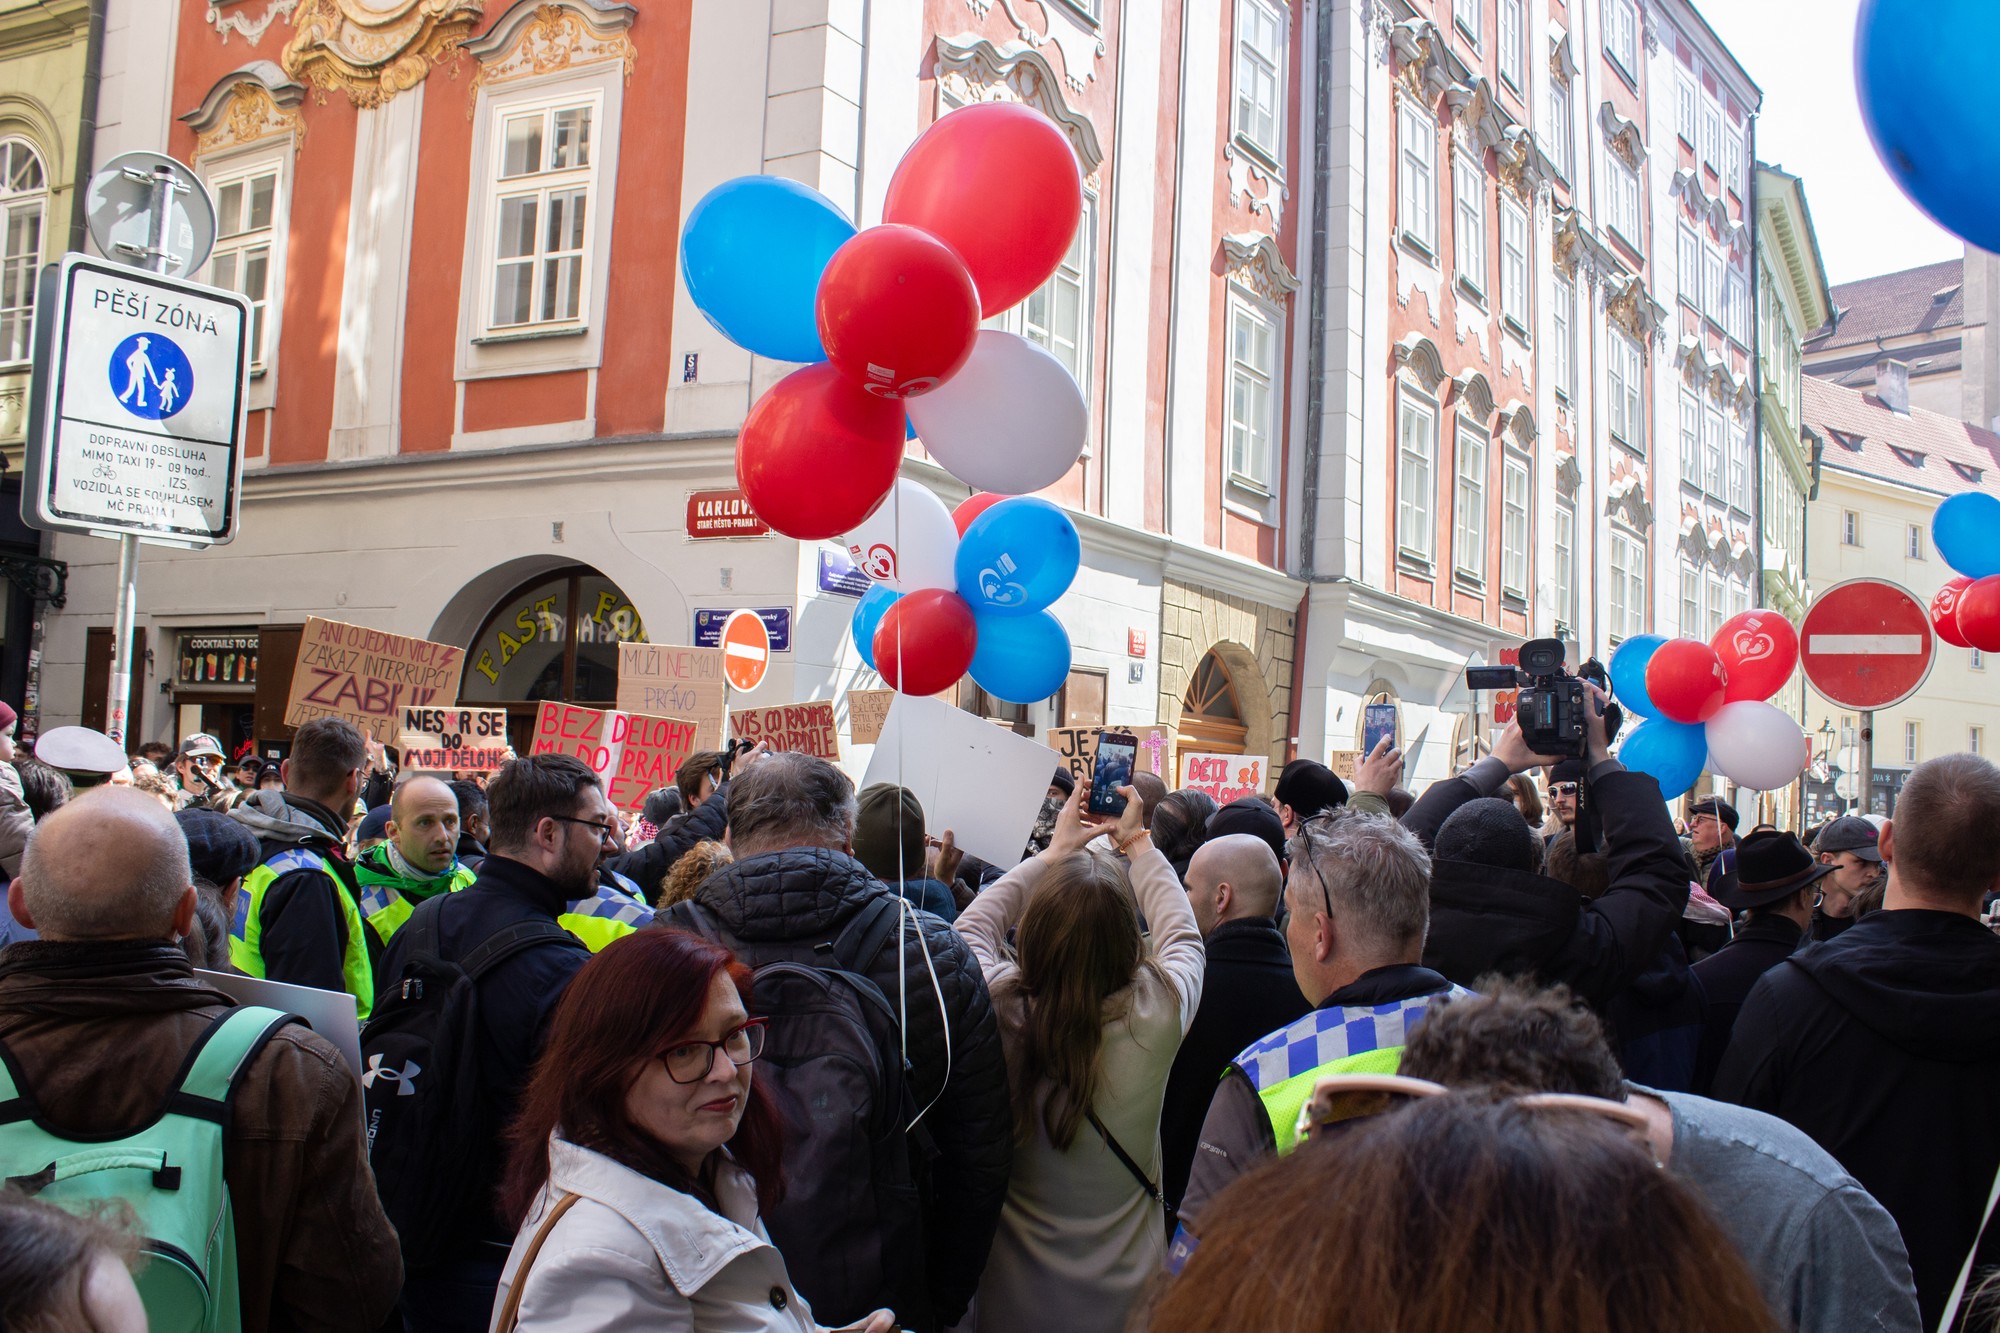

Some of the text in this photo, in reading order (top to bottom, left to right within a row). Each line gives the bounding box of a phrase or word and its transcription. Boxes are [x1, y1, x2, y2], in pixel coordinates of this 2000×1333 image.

[94, 288, 218, 336] PĚŠÍ ZÓNA
[82, 448, 113, 463] MIMO
[117, 454, 141, 467] TAXI
[145, 457, 155, 469] 19
[168, 462, 181, 473] 09
[152, 444, 206, 461] OBSLUHA
[73, 479, 213, 508] VOZIDLA SE SOUHLASEM
[107, 499, 175, 518] MČ PRAHA 1
[697, 518, 713, 530] STARÉ
[754, 518, 758, 527] 1
[191, 639, 234, 649] COCKTAILS
[235, 639, 246, 649] TO
[319, 621, 343, 644] ANI
[348, 626, 359, 647] O
[360, 628, 405, 658] JEDNU
[475, 593, 557, 685] FAST
[592, 591, 650, 644] FO
[303, 642, 452, 690] ZÁKAZ INTERRUPCÍ
[624, 646, 723, 679] MUŽI NEMAJÍ
[1134, 665, 1141, 678] 14
[644, 683, 696, 711] PRÁVO
[850, 694, 856, 703] I
[371, 717, 388, 743] SE
[477, 711, 503, 736] SE
[540, 703, 603, 741] BEZ
[765, 709, 782, 733] CO
[852, 713, 873, 723] STILL
[852, 723, 872, 733] THIS
[441, 733, 462, 749] DO
[575, 743, 611, 773] DO
[1188, 757, 1228, 782] DĚTI
